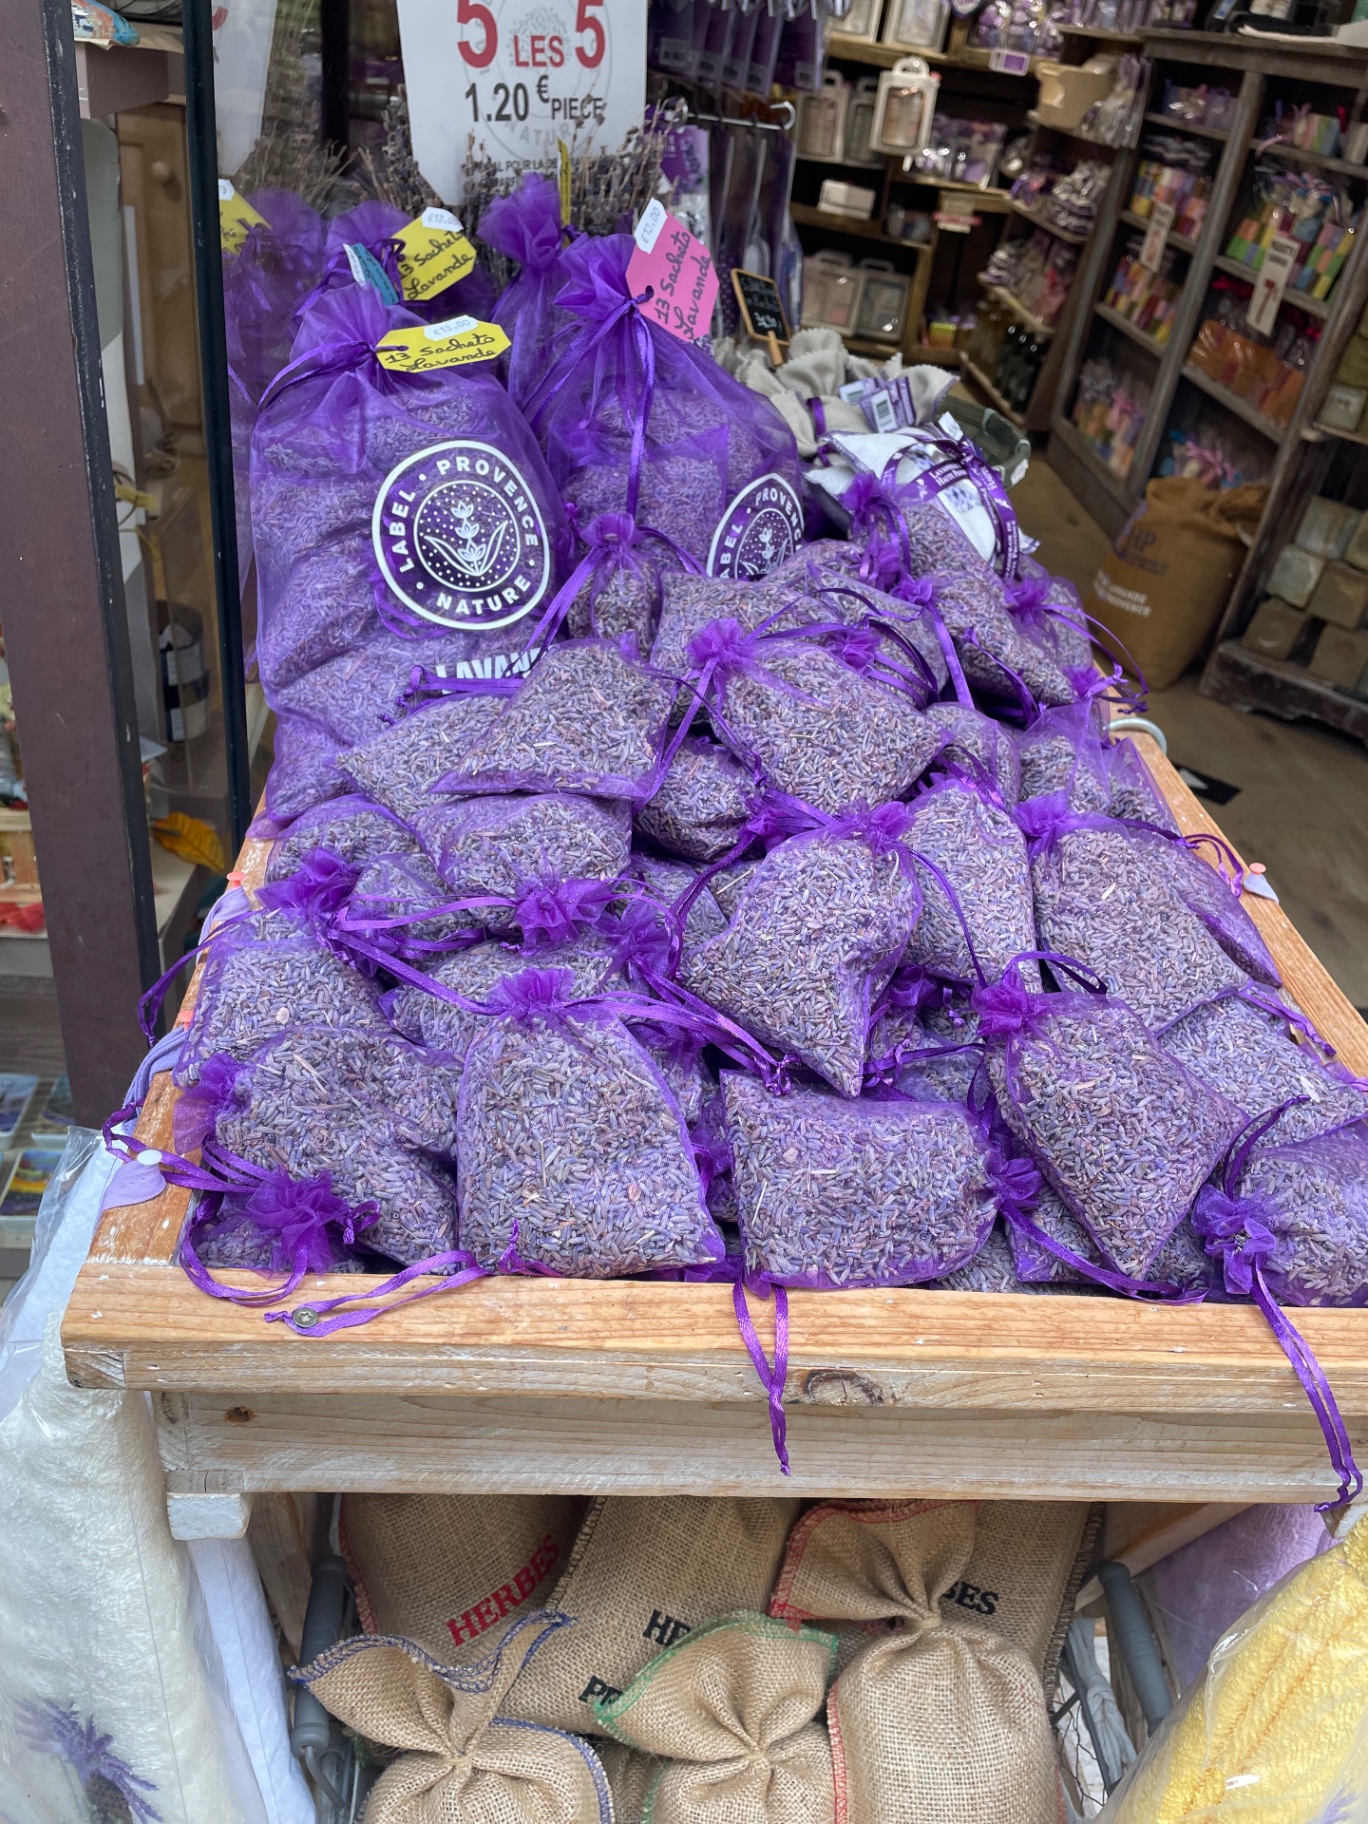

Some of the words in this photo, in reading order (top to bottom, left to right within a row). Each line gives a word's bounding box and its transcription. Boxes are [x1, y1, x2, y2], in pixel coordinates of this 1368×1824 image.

[457, 0, 498, 68] 5
[513, 35, 565, 68] LES
[575, 0, 606, 69] 5
[551, 98, 603, 120] PIECE
[654, 297, 671, 324] 13
[385, 352, 411, 364] 13
[436, 456, 539, 547] PROVENCE
[389, 490, 416, 573] LABEL
[720, 524, 743, 578] ABEL
[436, 574, 531, 616] NATURE
[446, 1534, 560, 1646] HERBES
